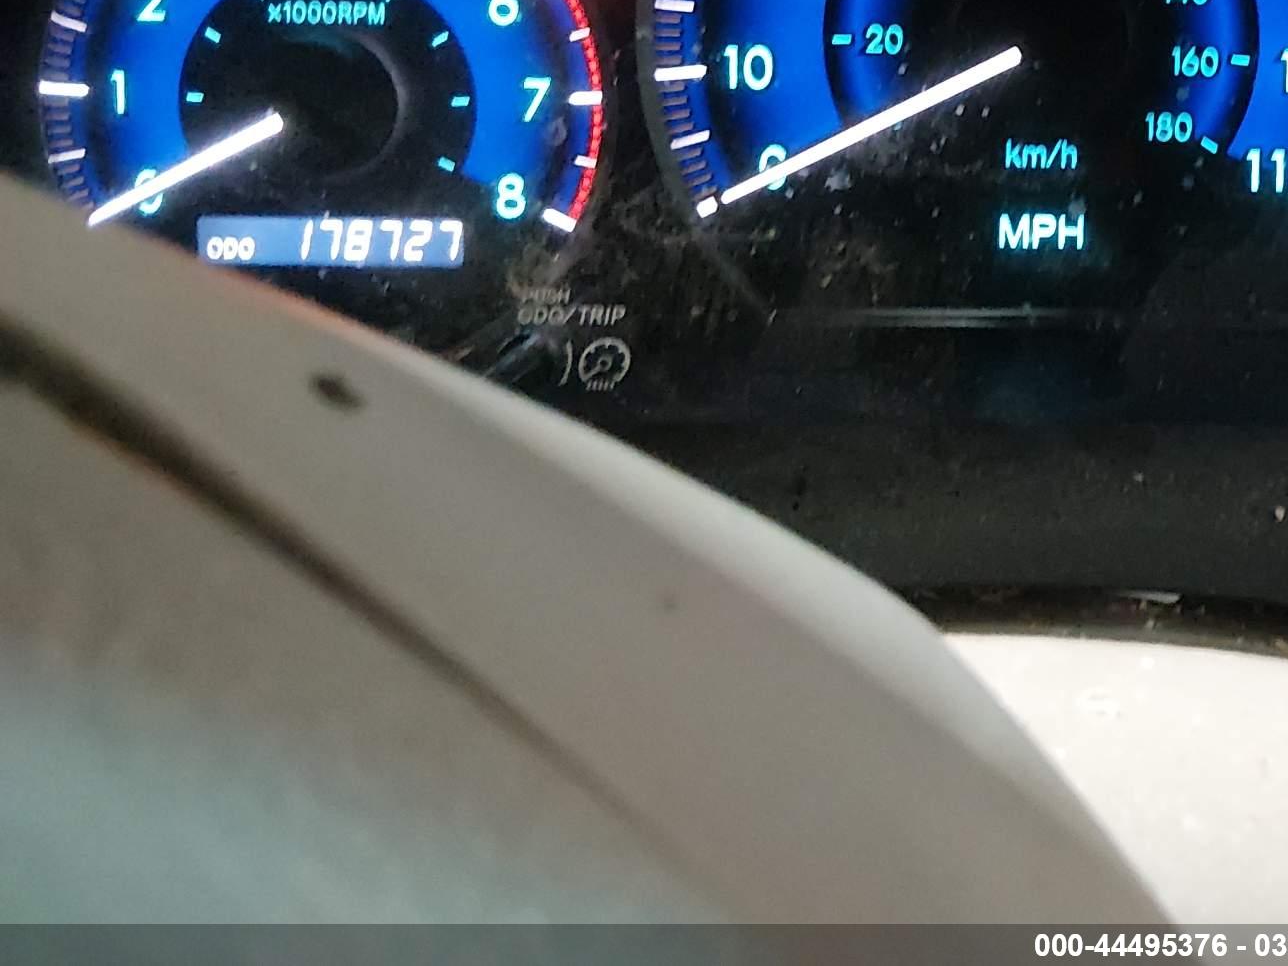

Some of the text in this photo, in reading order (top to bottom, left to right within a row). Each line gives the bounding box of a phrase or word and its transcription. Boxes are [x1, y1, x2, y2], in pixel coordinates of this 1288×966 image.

[865, 23, 904, 55] 20
[723, 43, 774, 91] 10
[1171, 46, 1219, 78] 160
[109, 69, 127, 115] 1
[522, 76, 552, 123] 7
[1145, 111, 1193, 143] 180
[1005, 138, 1078, 170] km/h
[494, 172, 527, 220] 8
[207, 220, 464, 262] ODO 178727
[998, 212, 1085, 250] MPH
